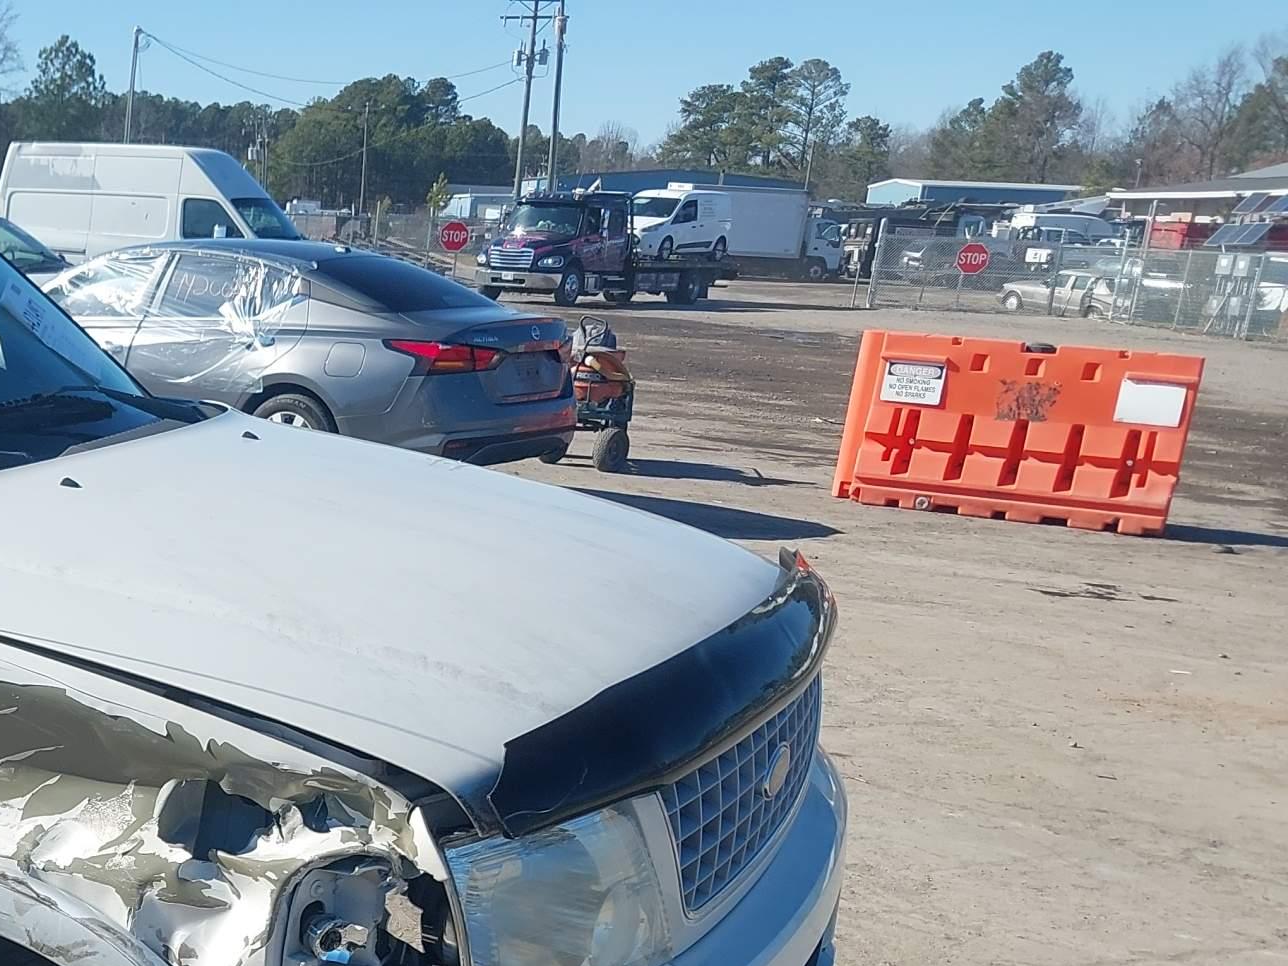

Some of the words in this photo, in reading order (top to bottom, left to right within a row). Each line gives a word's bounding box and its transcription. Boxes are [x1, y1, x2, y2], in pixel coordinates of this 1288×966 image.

[442, 230, 467, 243] STOP
[958, 252, 987, 265] STOP
[895, 364, 935, 377] DANGER
[905, 378, 931, 386] SMOKING
[904, 391, 927, 399] SPARKS
